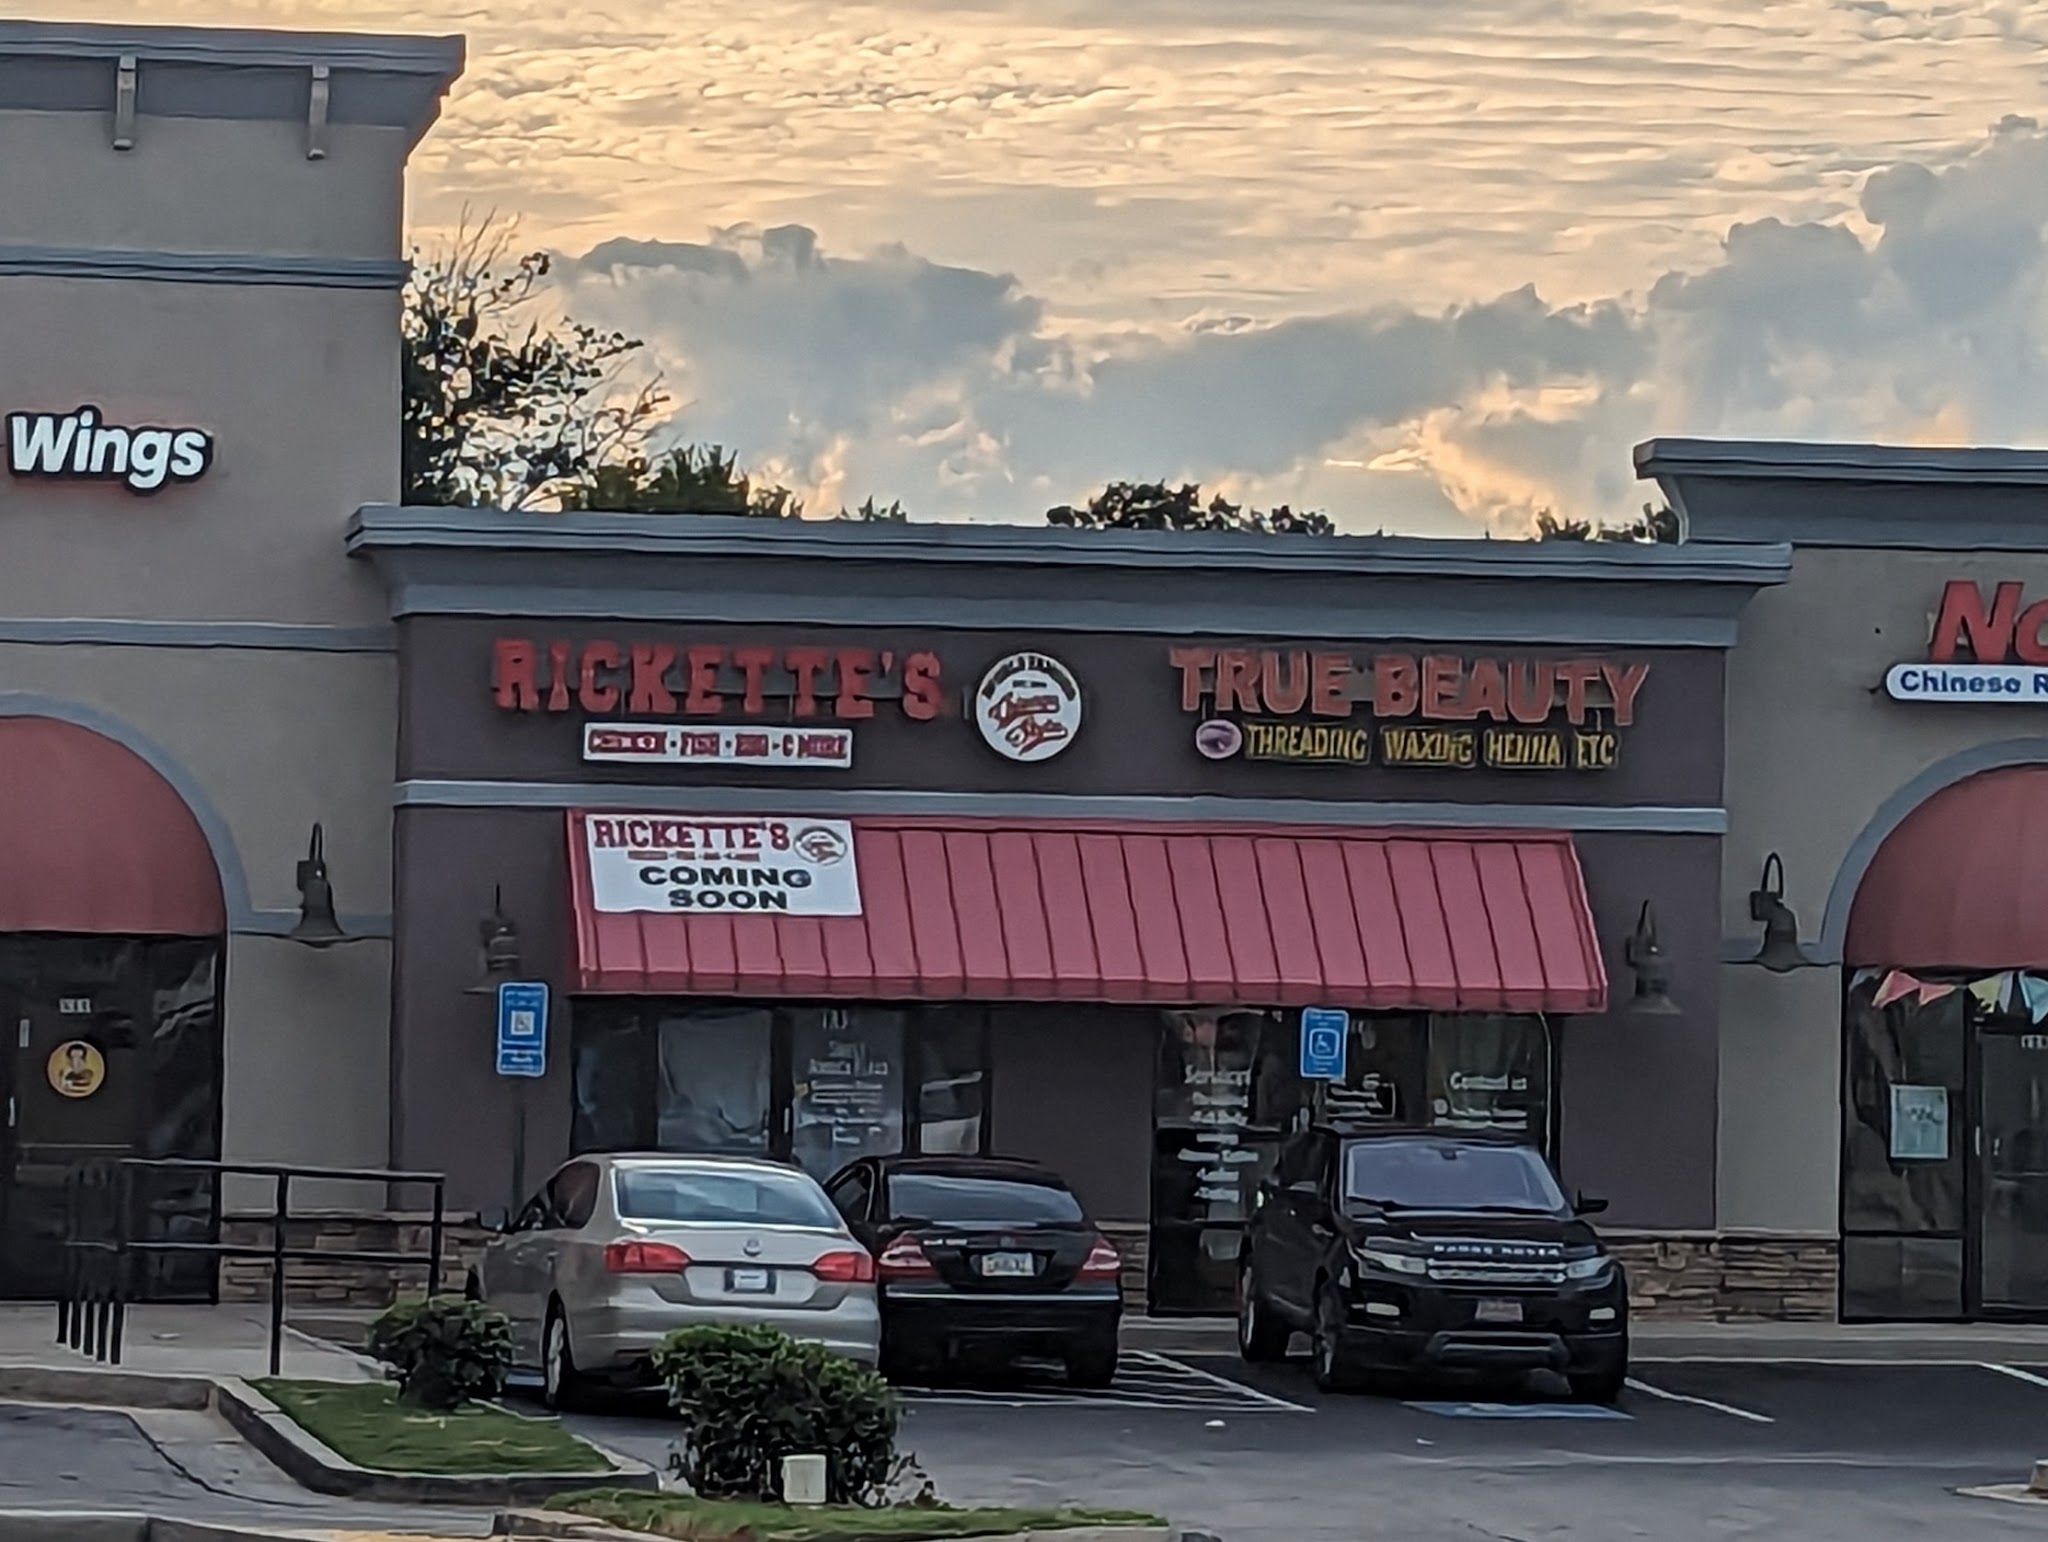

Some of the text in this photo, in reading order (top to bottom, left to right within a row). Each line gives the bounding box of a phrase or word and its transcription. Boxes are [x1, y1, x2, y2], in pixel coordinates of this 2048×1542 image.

[11, 410, 207, 489] Wings
[494, 637, 943, 721] RICKETTE'S
[1168, 645, 1650, 726] TRUE BEAUTY
[1246, 722, 1369, 762] THREADING
[639, 867, 812, 888] COMING
[668, 889, 788, 909] SOON
